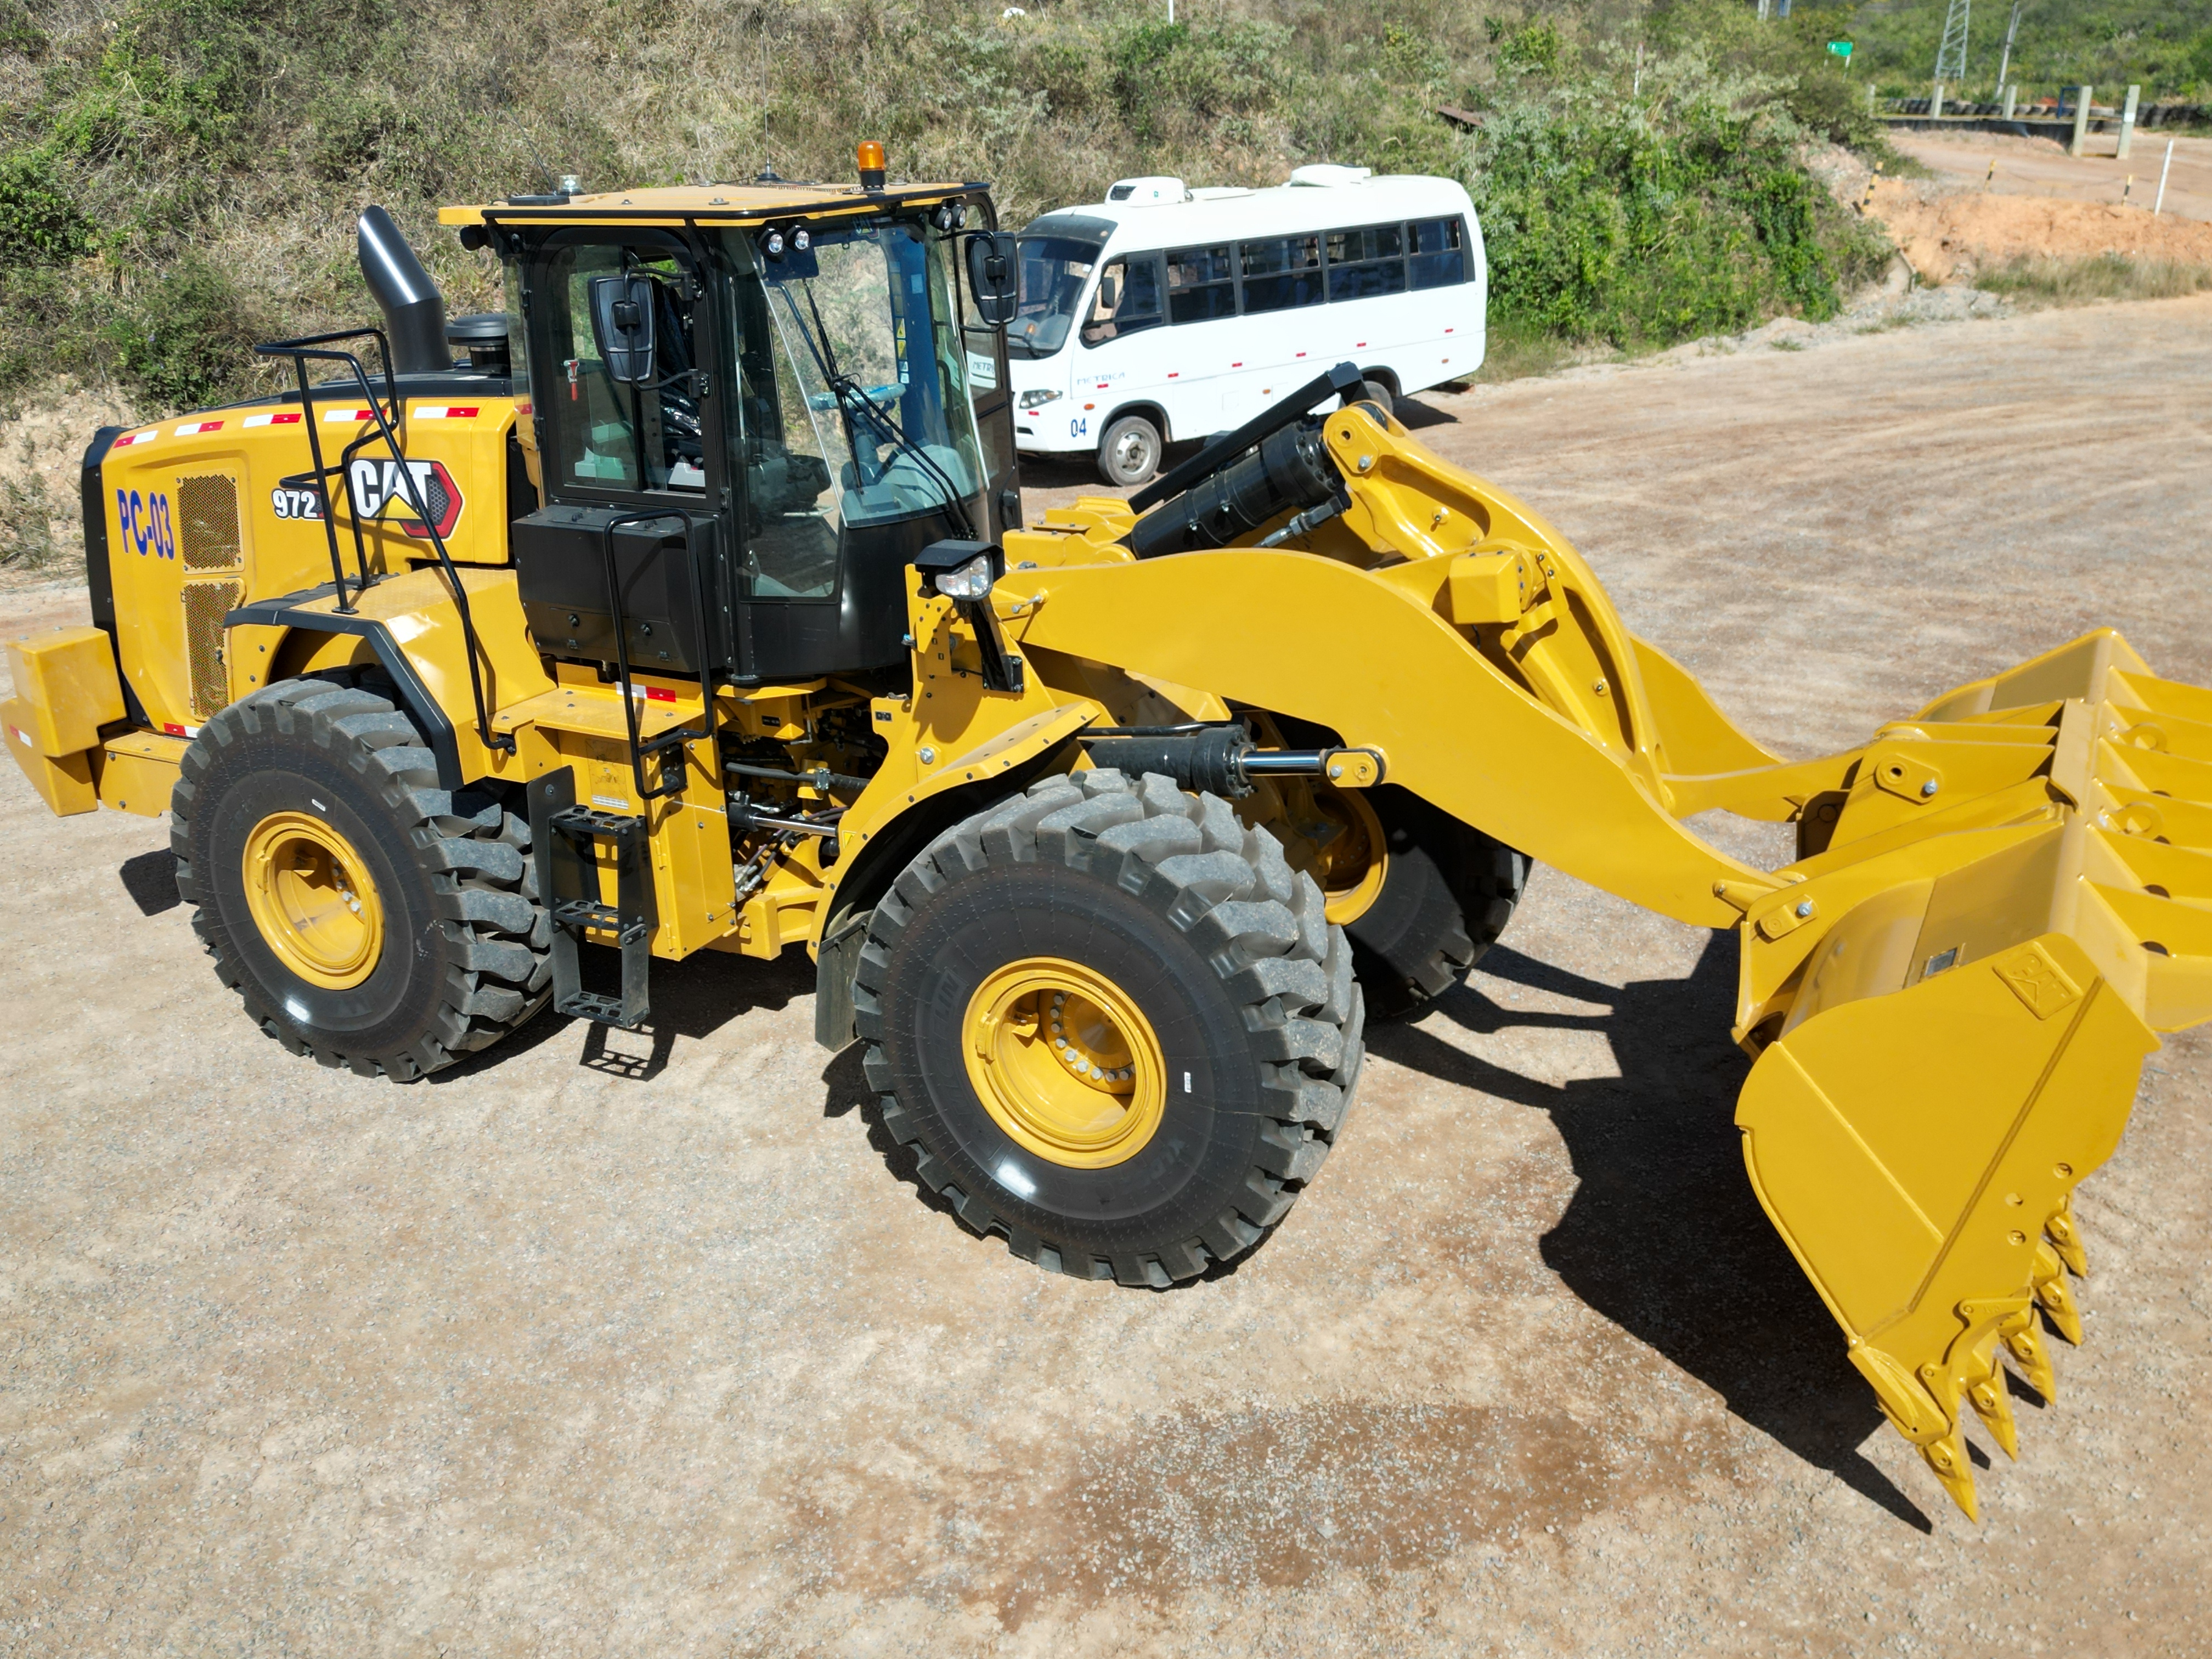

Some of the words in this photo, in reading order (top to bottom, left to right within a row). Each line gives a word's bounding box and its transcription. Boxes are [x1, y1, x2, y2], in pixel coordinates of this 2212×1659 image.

[1070, 417, 1087, 437] 04
[272, 489, 318, 518] 972
[351, 459, 432, 518] CAT
[116, 488, 174, 560] PC-03
[2005, 952, 2072, 1007] CAT
